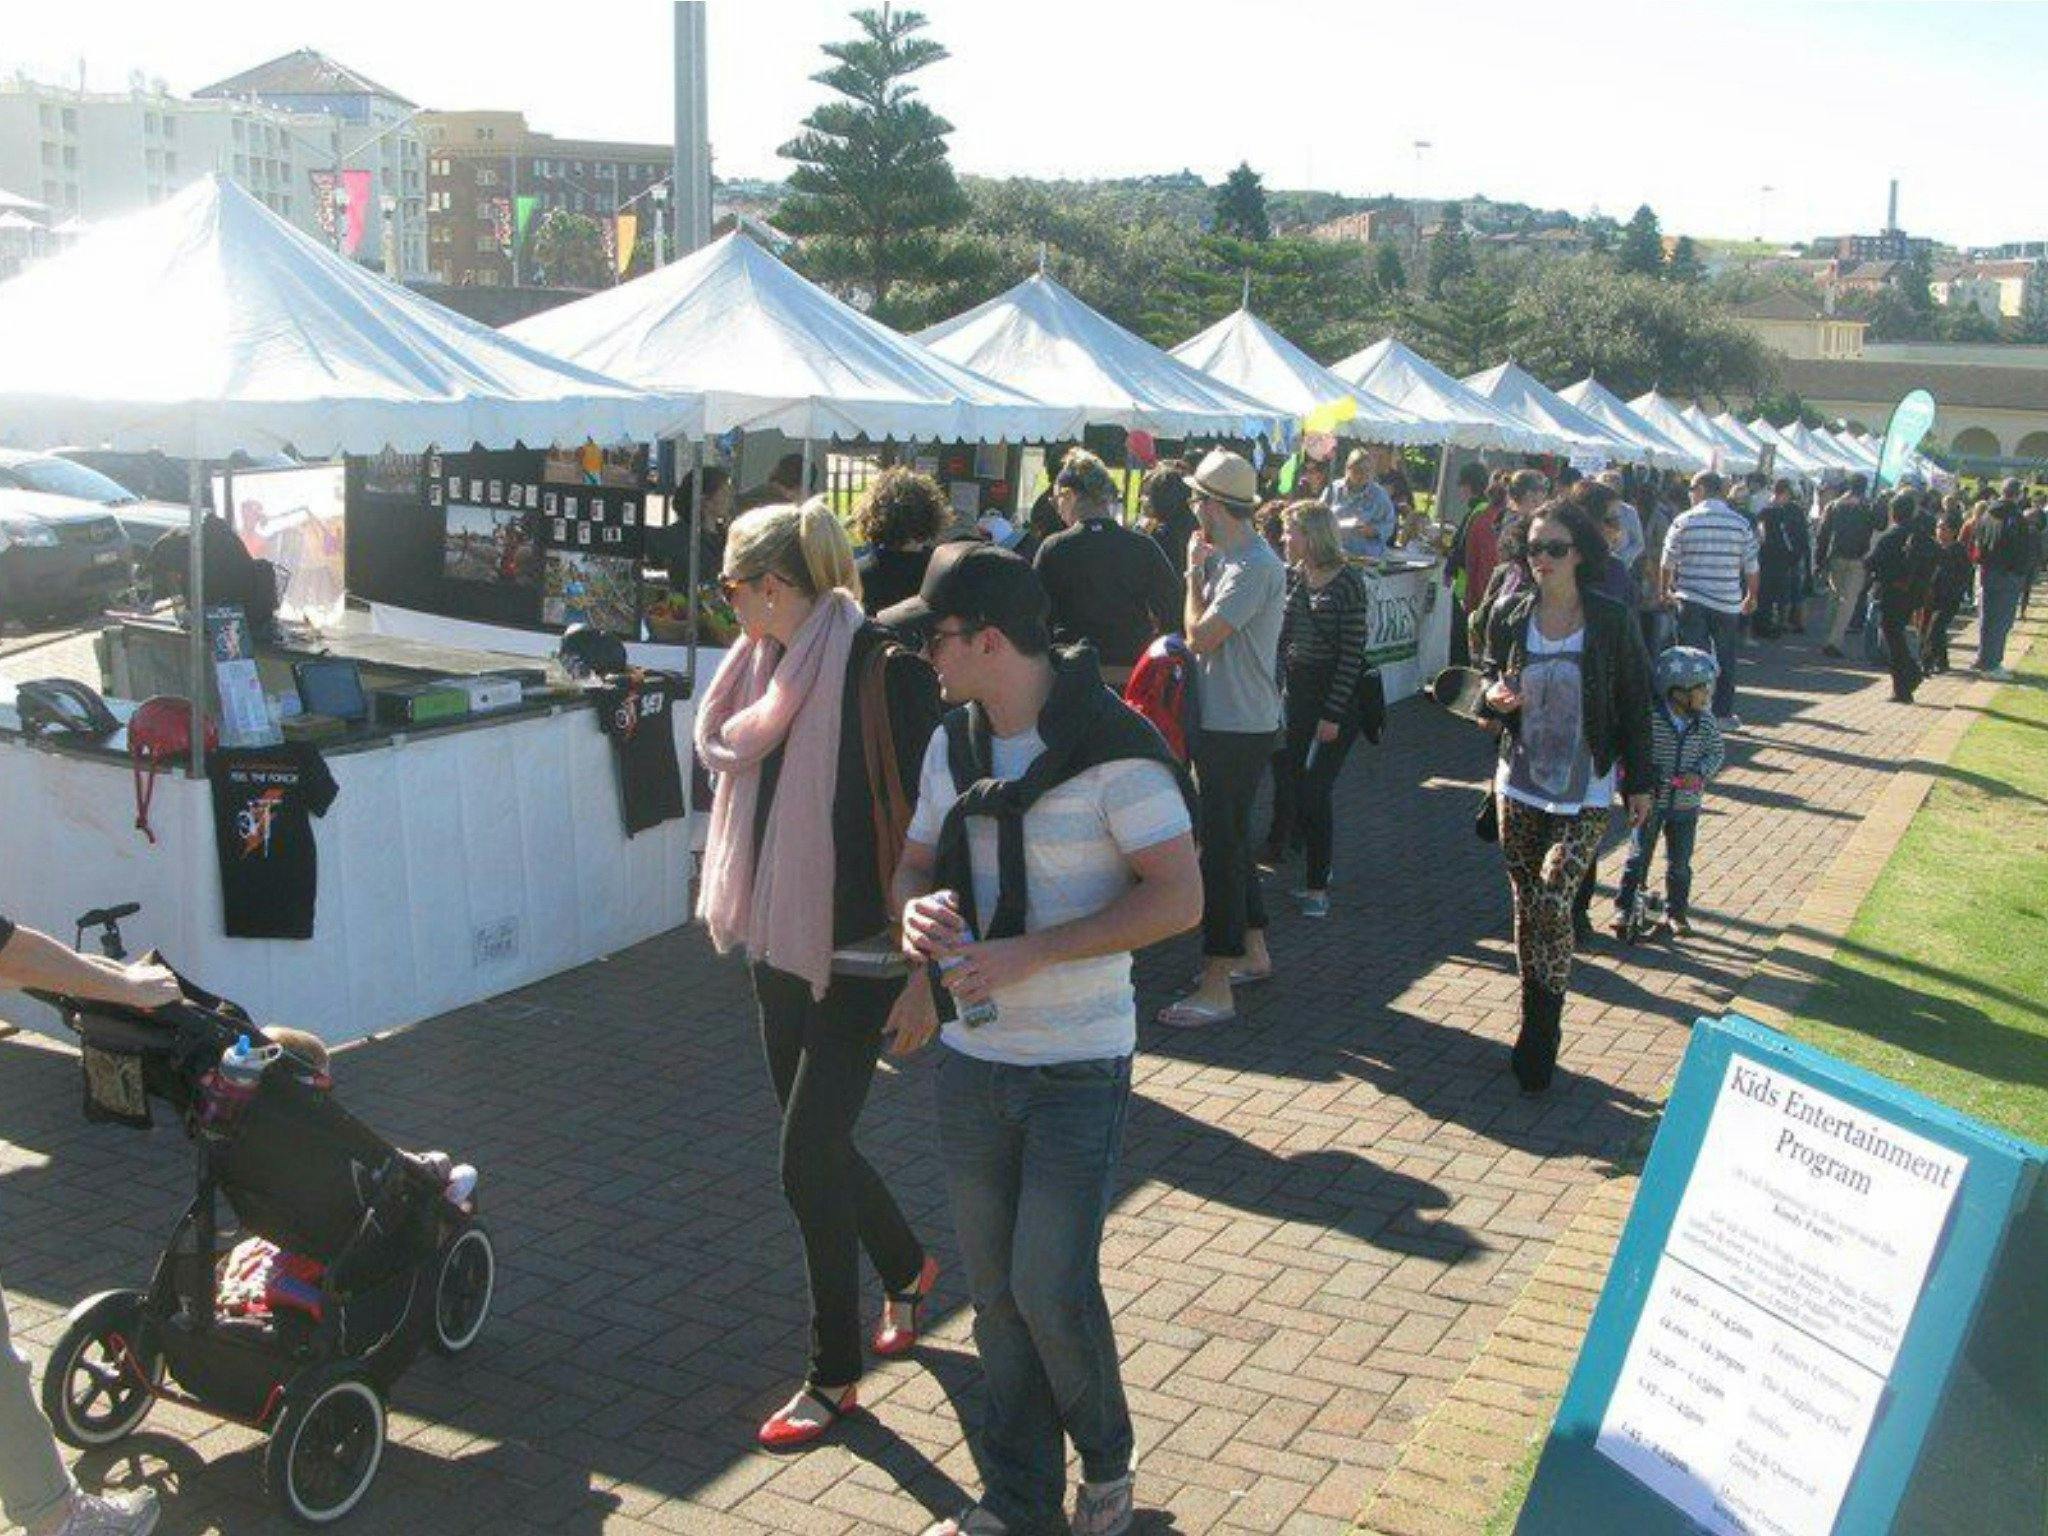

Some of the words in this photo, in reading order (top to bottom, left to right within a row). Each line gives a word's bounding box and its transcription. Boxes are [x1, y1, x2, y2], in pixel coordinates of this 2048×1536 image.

[1731, 1065, 1779, 1106] Kids
[1783, 1090, 1954, 1189] Entertainment
[1776, 1128, 1872, 1195] Program
